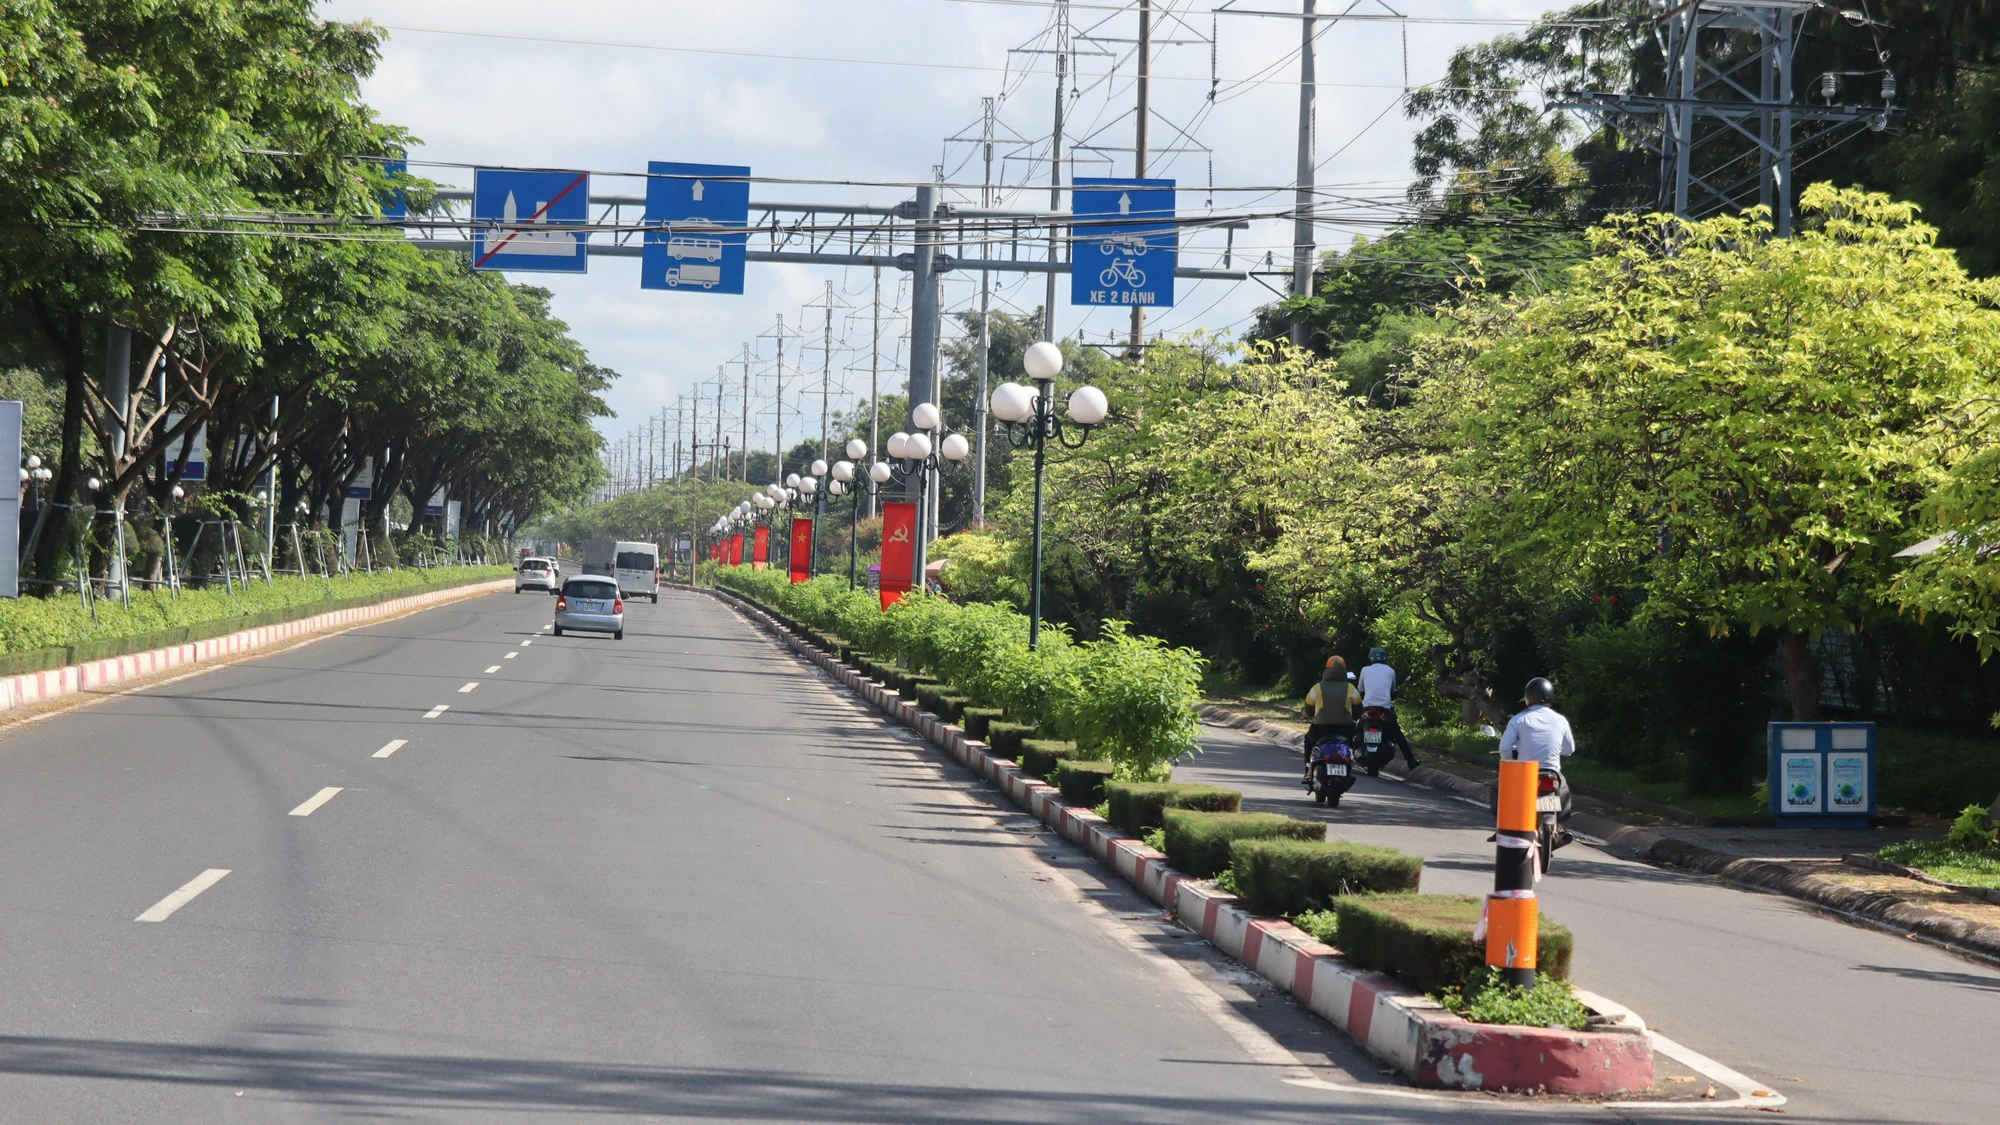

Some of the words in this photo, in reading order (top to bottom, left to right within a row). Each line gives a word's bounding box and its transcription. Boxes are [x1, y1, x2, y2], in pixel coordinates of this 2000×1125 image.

[1090, 290, 1106, 303] XE
[1110, 291, 1118, 303] 2
[1122, 289, 1155, 304] BÁNH
